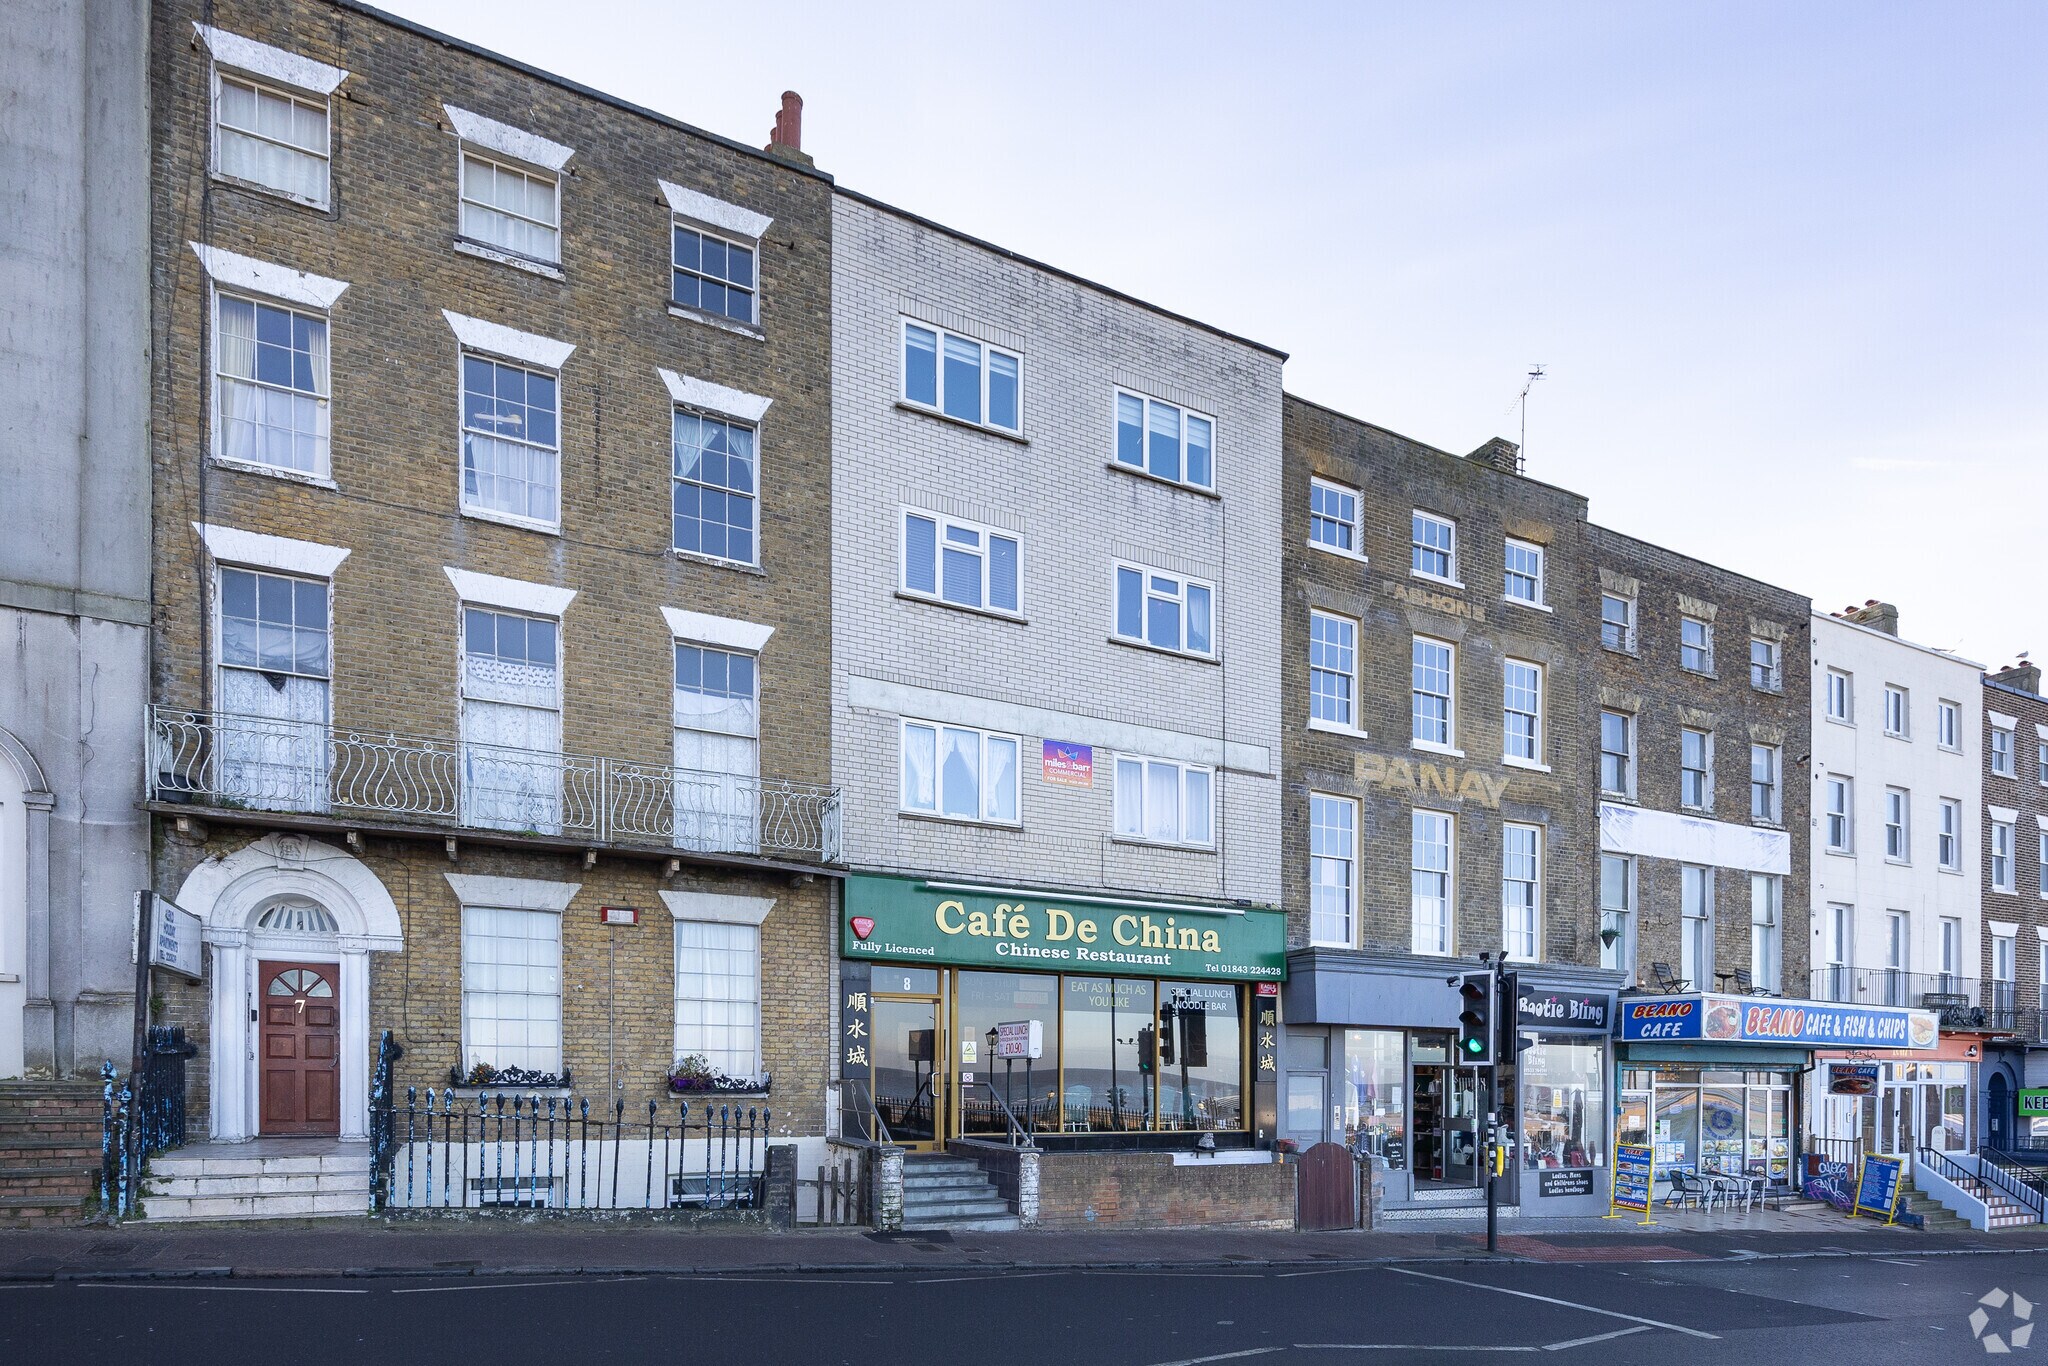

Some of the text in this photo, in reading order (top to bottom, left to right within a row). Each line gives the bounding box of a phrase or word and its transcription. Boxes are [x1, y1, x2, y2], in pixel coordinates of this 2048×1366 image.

[1048, 767, 1087, 779] COMMERCIAL
[1354, 751, 1512, 808] PANAY
[934, 900, 1222, 953] Café De China
[852, 940, 935, 956] Fully Licenced
[995, 942, 1172, 966] Chinese Restaurant
[1205, 963, 1282, 976] Tel 01843 224428
[903, 977, 911, 991] 8
[1071, 981, 1147, 996] EAT AS MUCH AS
[1170, 987, 1232, 999] SPECIAL LUNCH
[294, 1000, 306, 1014] 7
[1088, 995, 1130, 1008] YOU LIKE
[1175, 1000, 1227, 1011] NOODLE BAR
[1519, 996, 1604, 1026] Bootie Bling
[1632, 1002, 1693, 1019] BEANO
[846, 992, 869, 1067] 順水城
[1640, 1022, 1683, 1038] CAFE
[1745, 1006, 1906, 1040] BEANO CAFE & FISH & CHIPS
[1260, 1009, 1276, 1072] 順水城
[1831, 1065, 1877, 1075] BEANO CAFE
